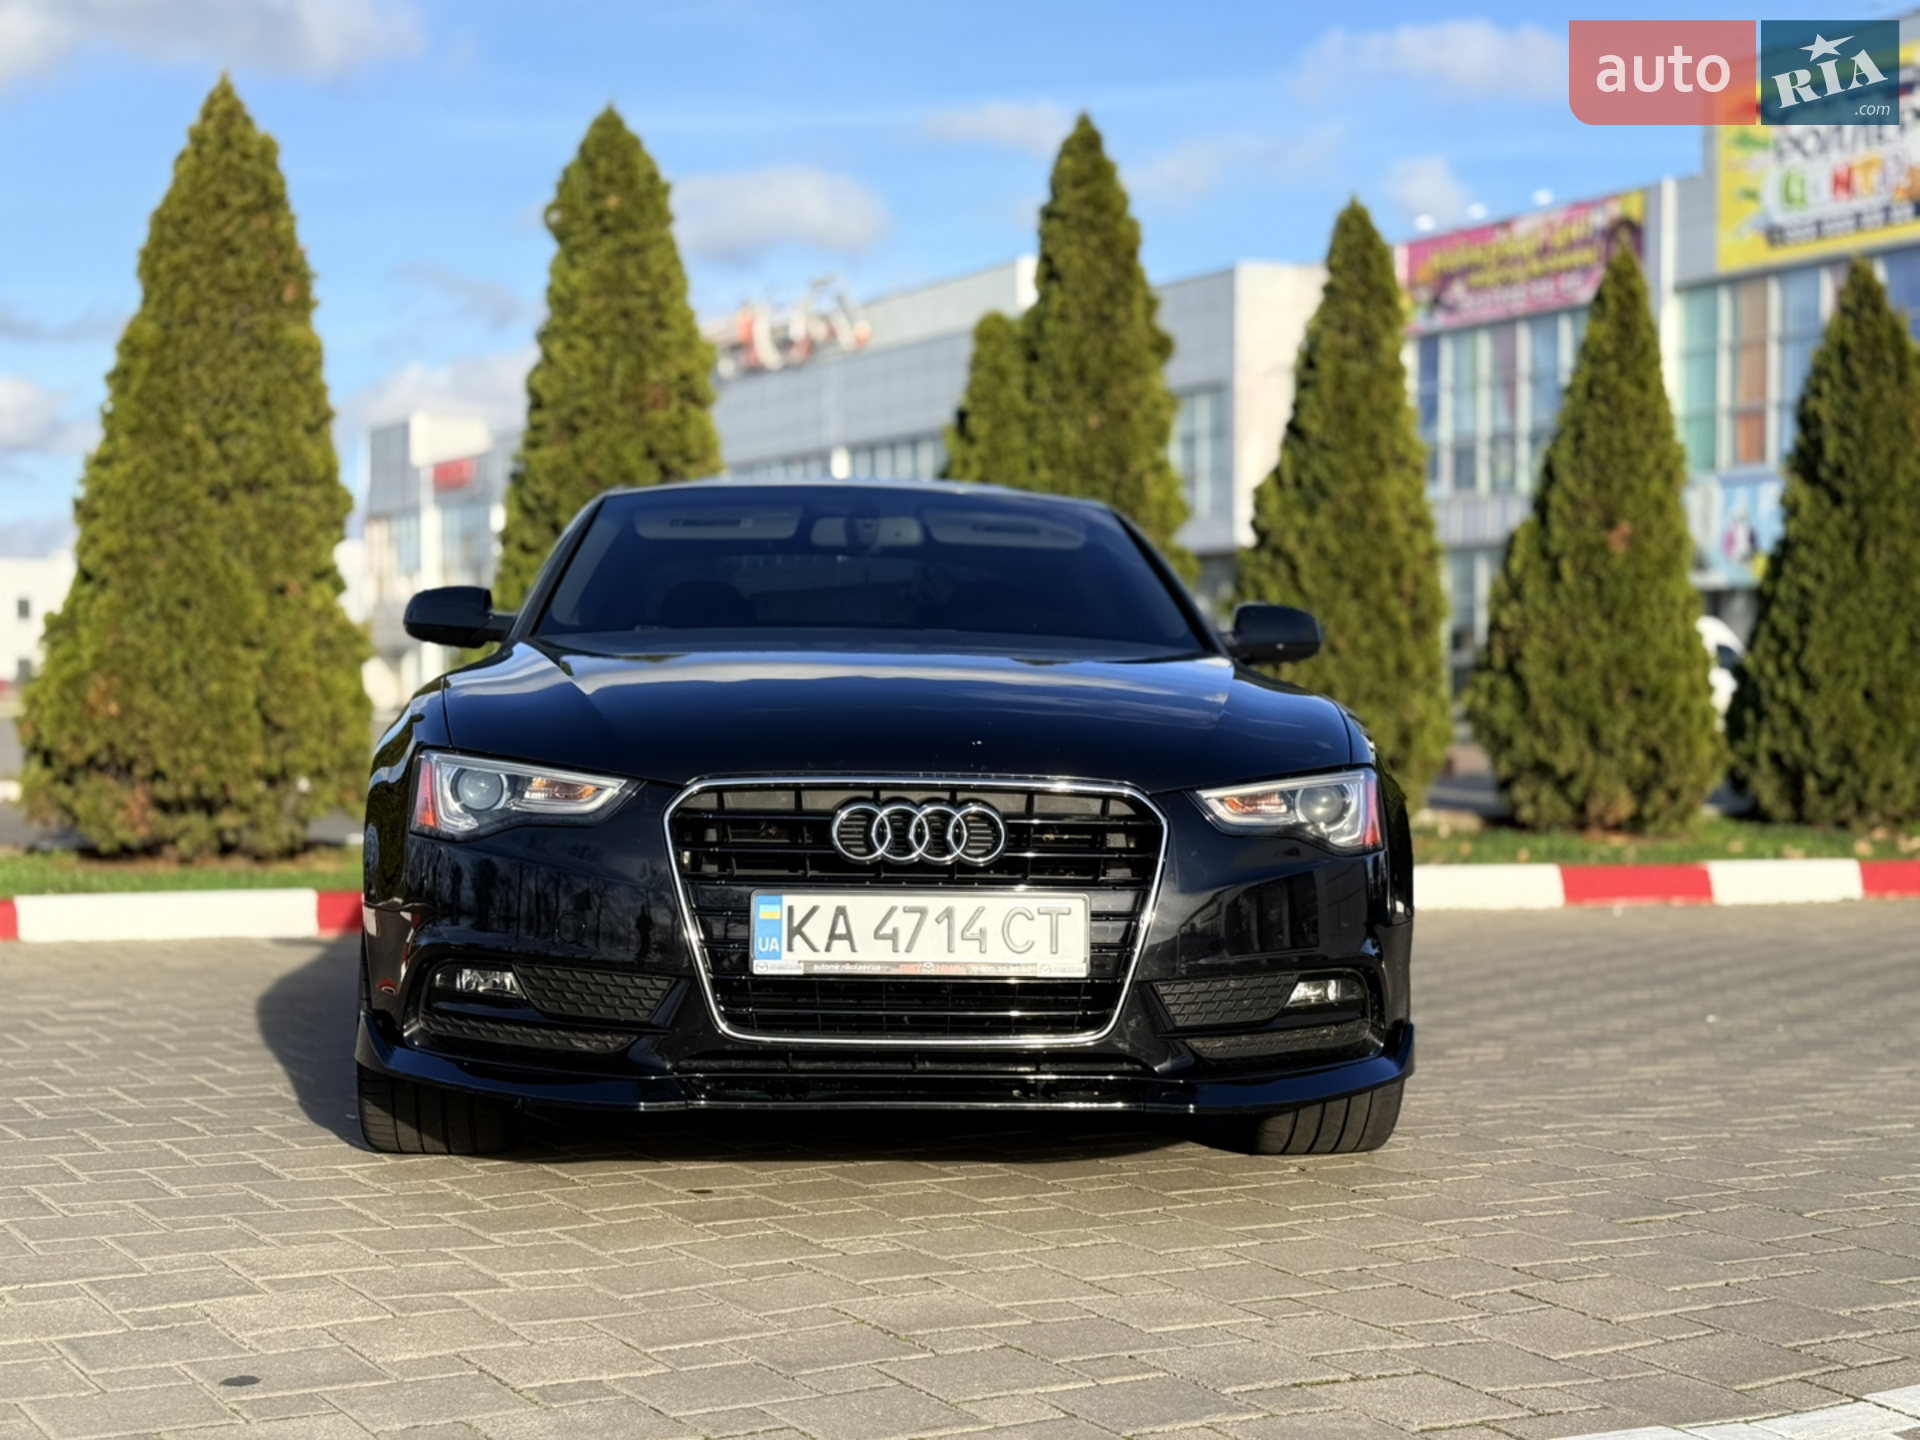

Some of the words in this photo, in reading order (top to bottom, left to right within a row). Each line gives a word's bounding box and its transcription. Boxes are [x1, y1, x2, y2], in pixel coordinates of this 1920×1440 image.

[758, 937, 780, 953] UA
[786, 904, 858, 953] KA
[873, 905, 988, 954] 4714
[1001, 906, 1072, 955] CT
